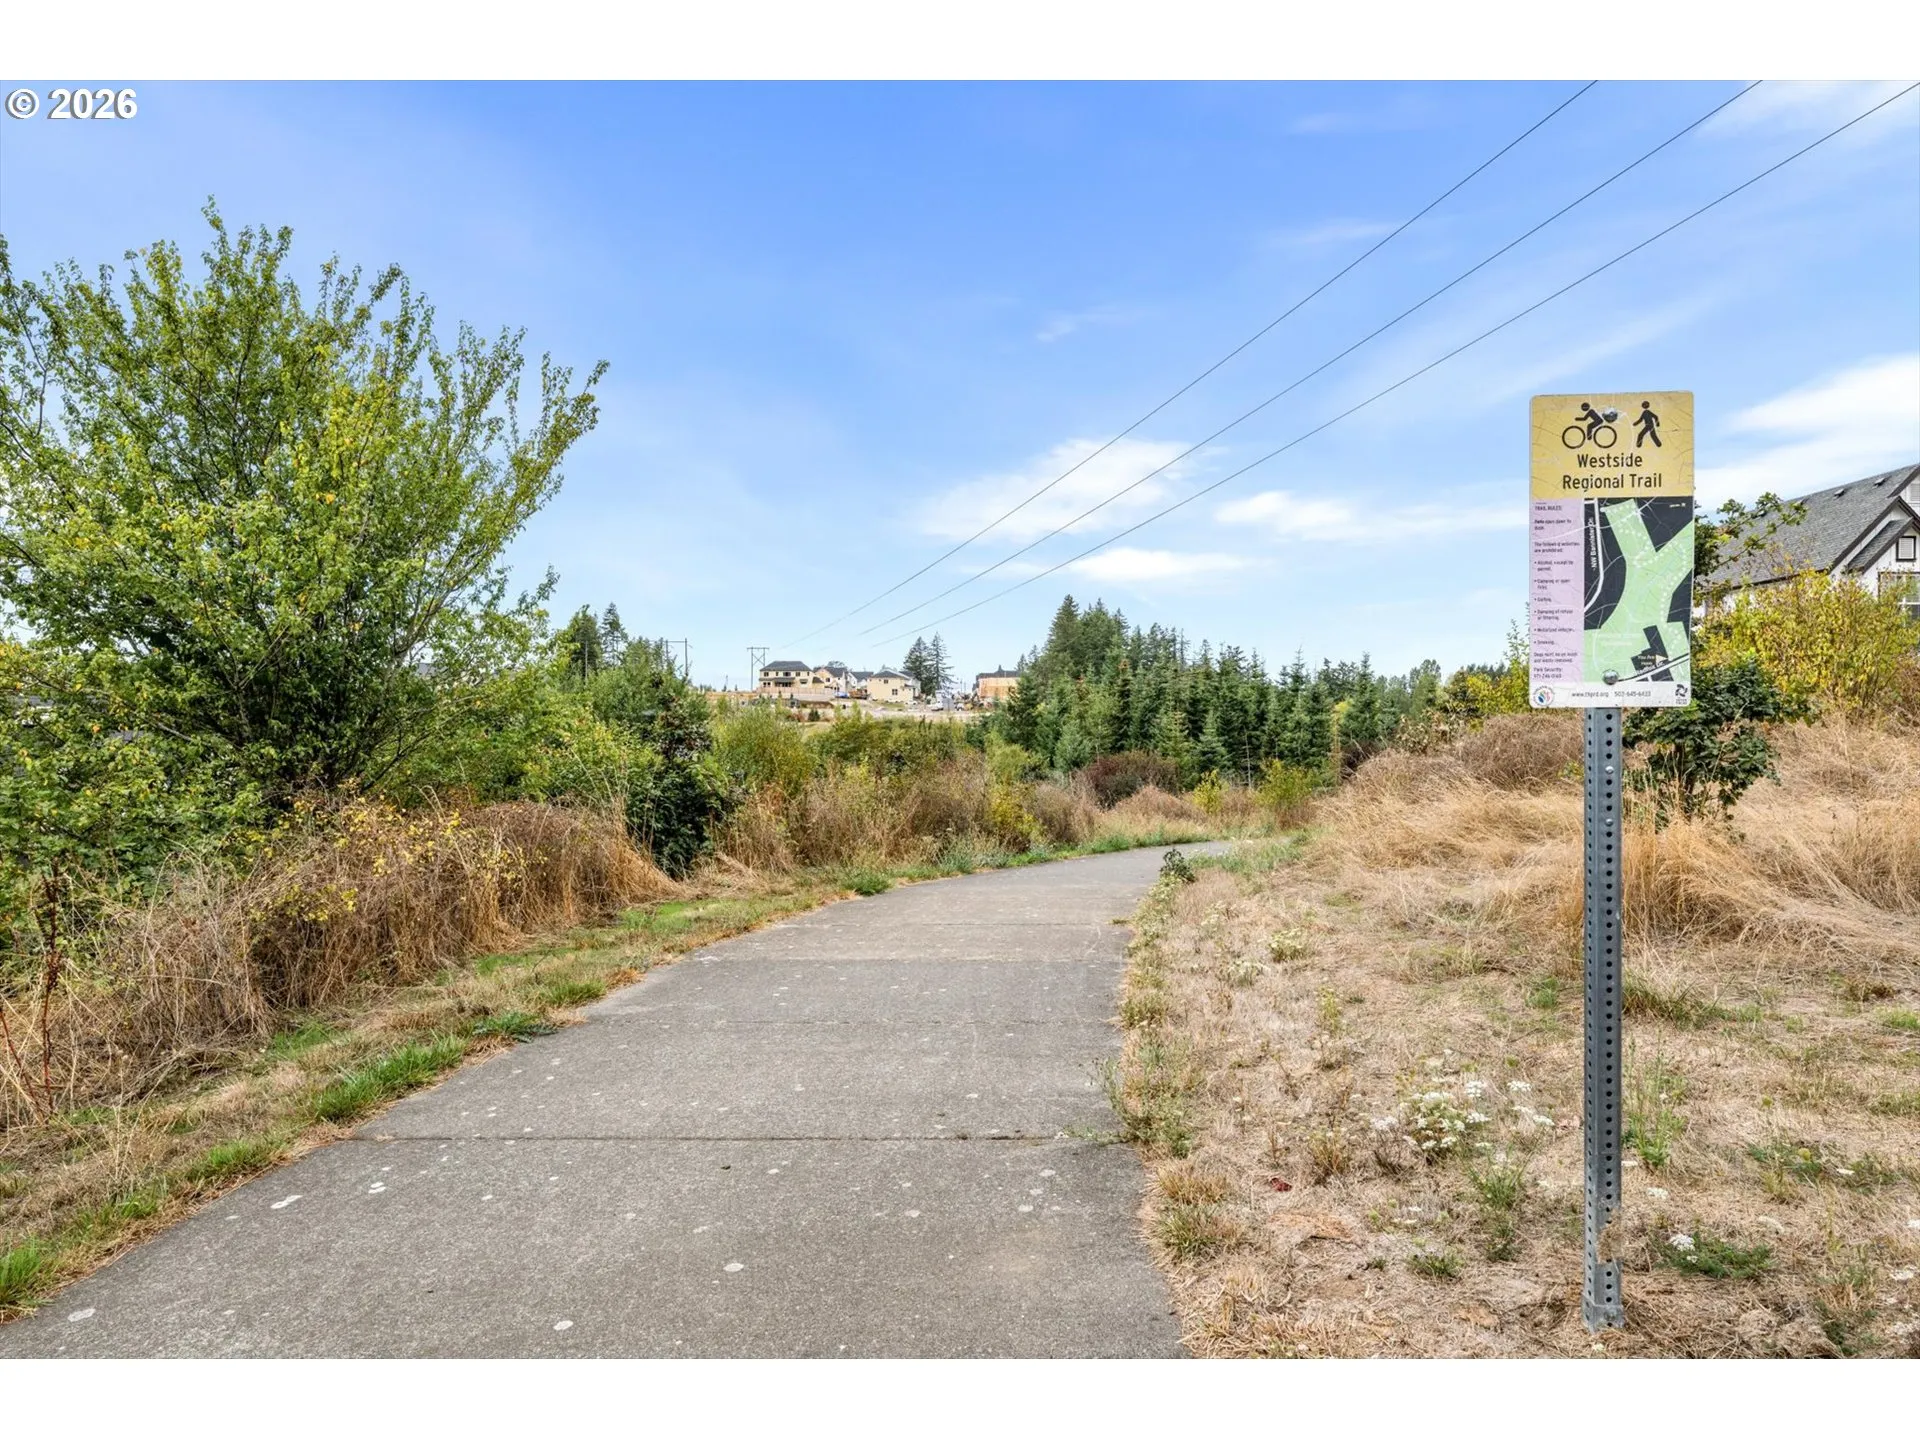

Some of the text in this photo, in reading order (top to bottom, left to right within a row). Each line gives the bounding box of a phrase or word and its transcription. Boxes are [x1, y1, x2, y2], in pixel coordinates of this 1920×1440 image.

[1577, 453, 1643, 468] Westside
[1562, 473, 1662, 492] Regional Trail
